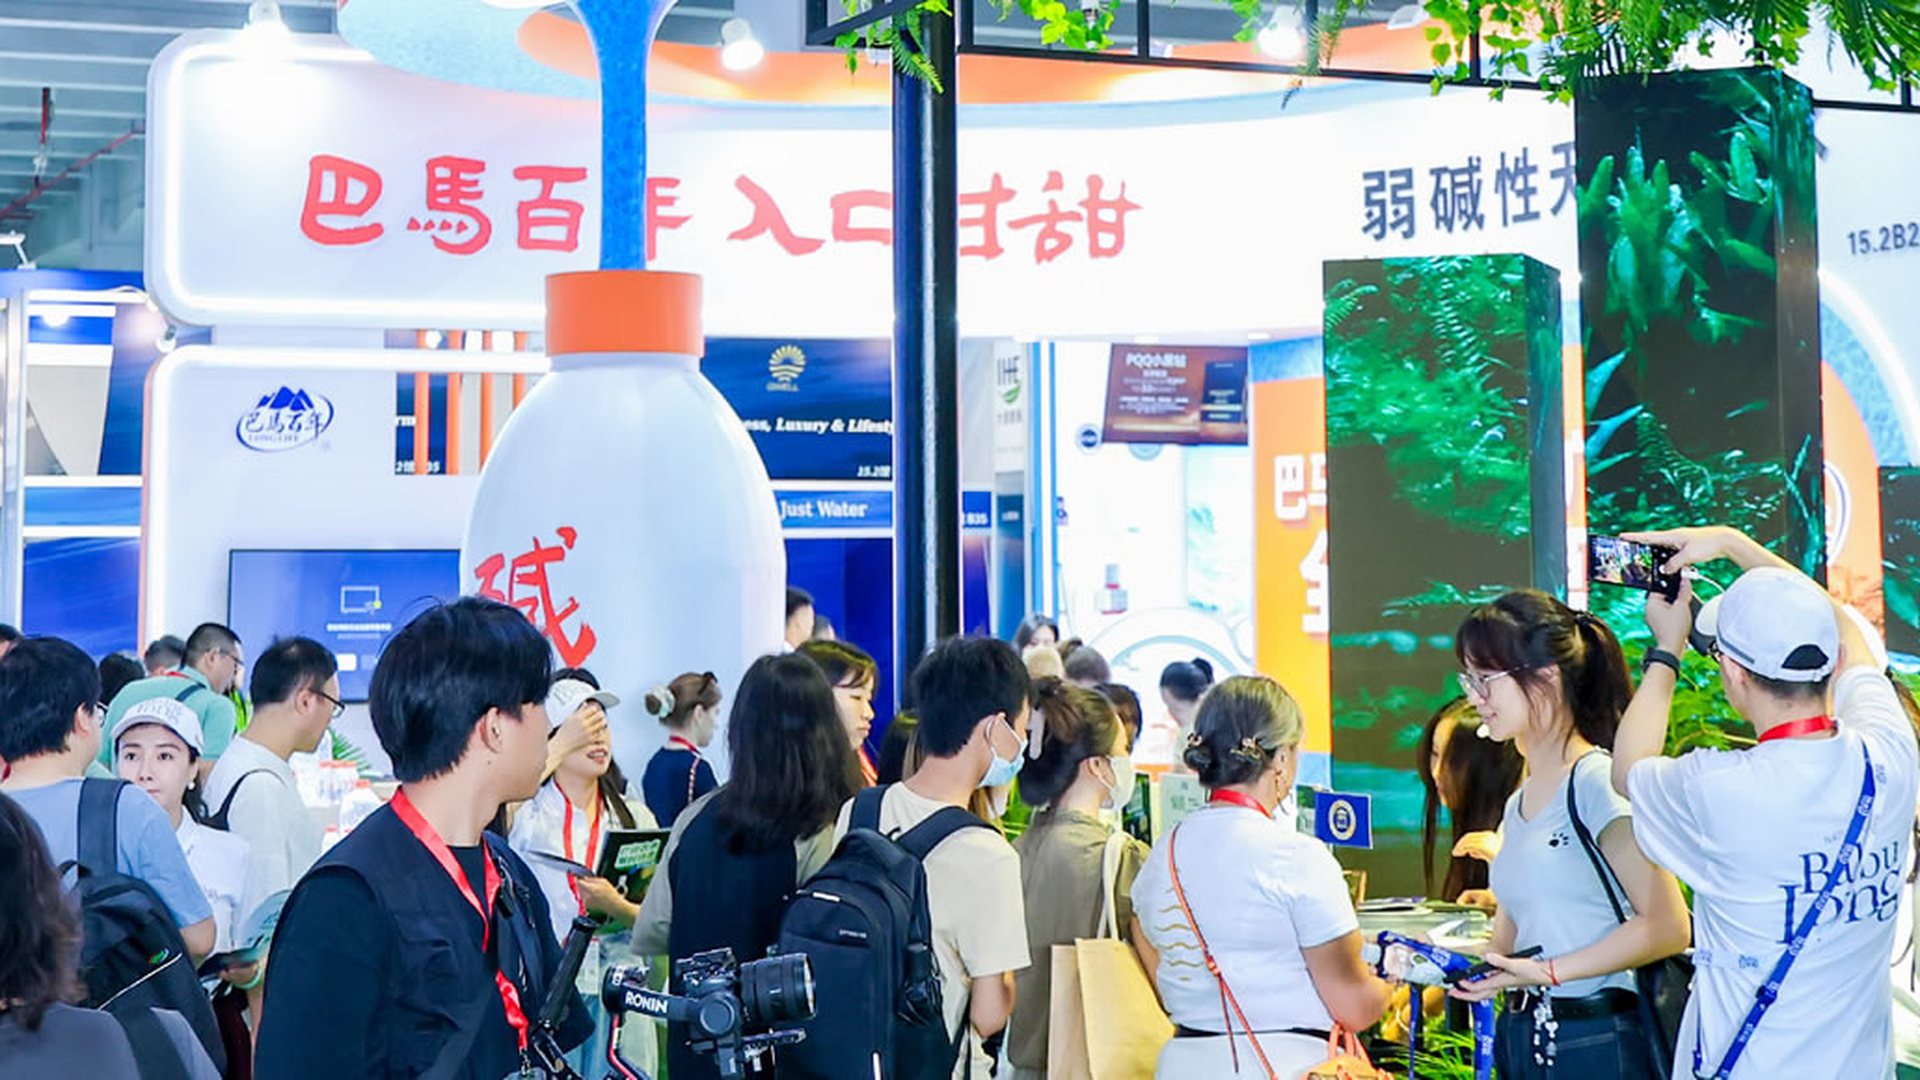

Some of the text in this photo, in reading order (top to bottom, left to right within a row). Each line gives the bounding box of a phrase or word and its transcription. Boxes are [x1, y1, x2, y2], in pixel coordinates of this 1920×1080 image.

[775, 416, 829, 435] Luxury
[830, 419, 844, 432] &
[779, 500, 868, 519] Just Water
[624, 991, 668, 1014] RONIN
